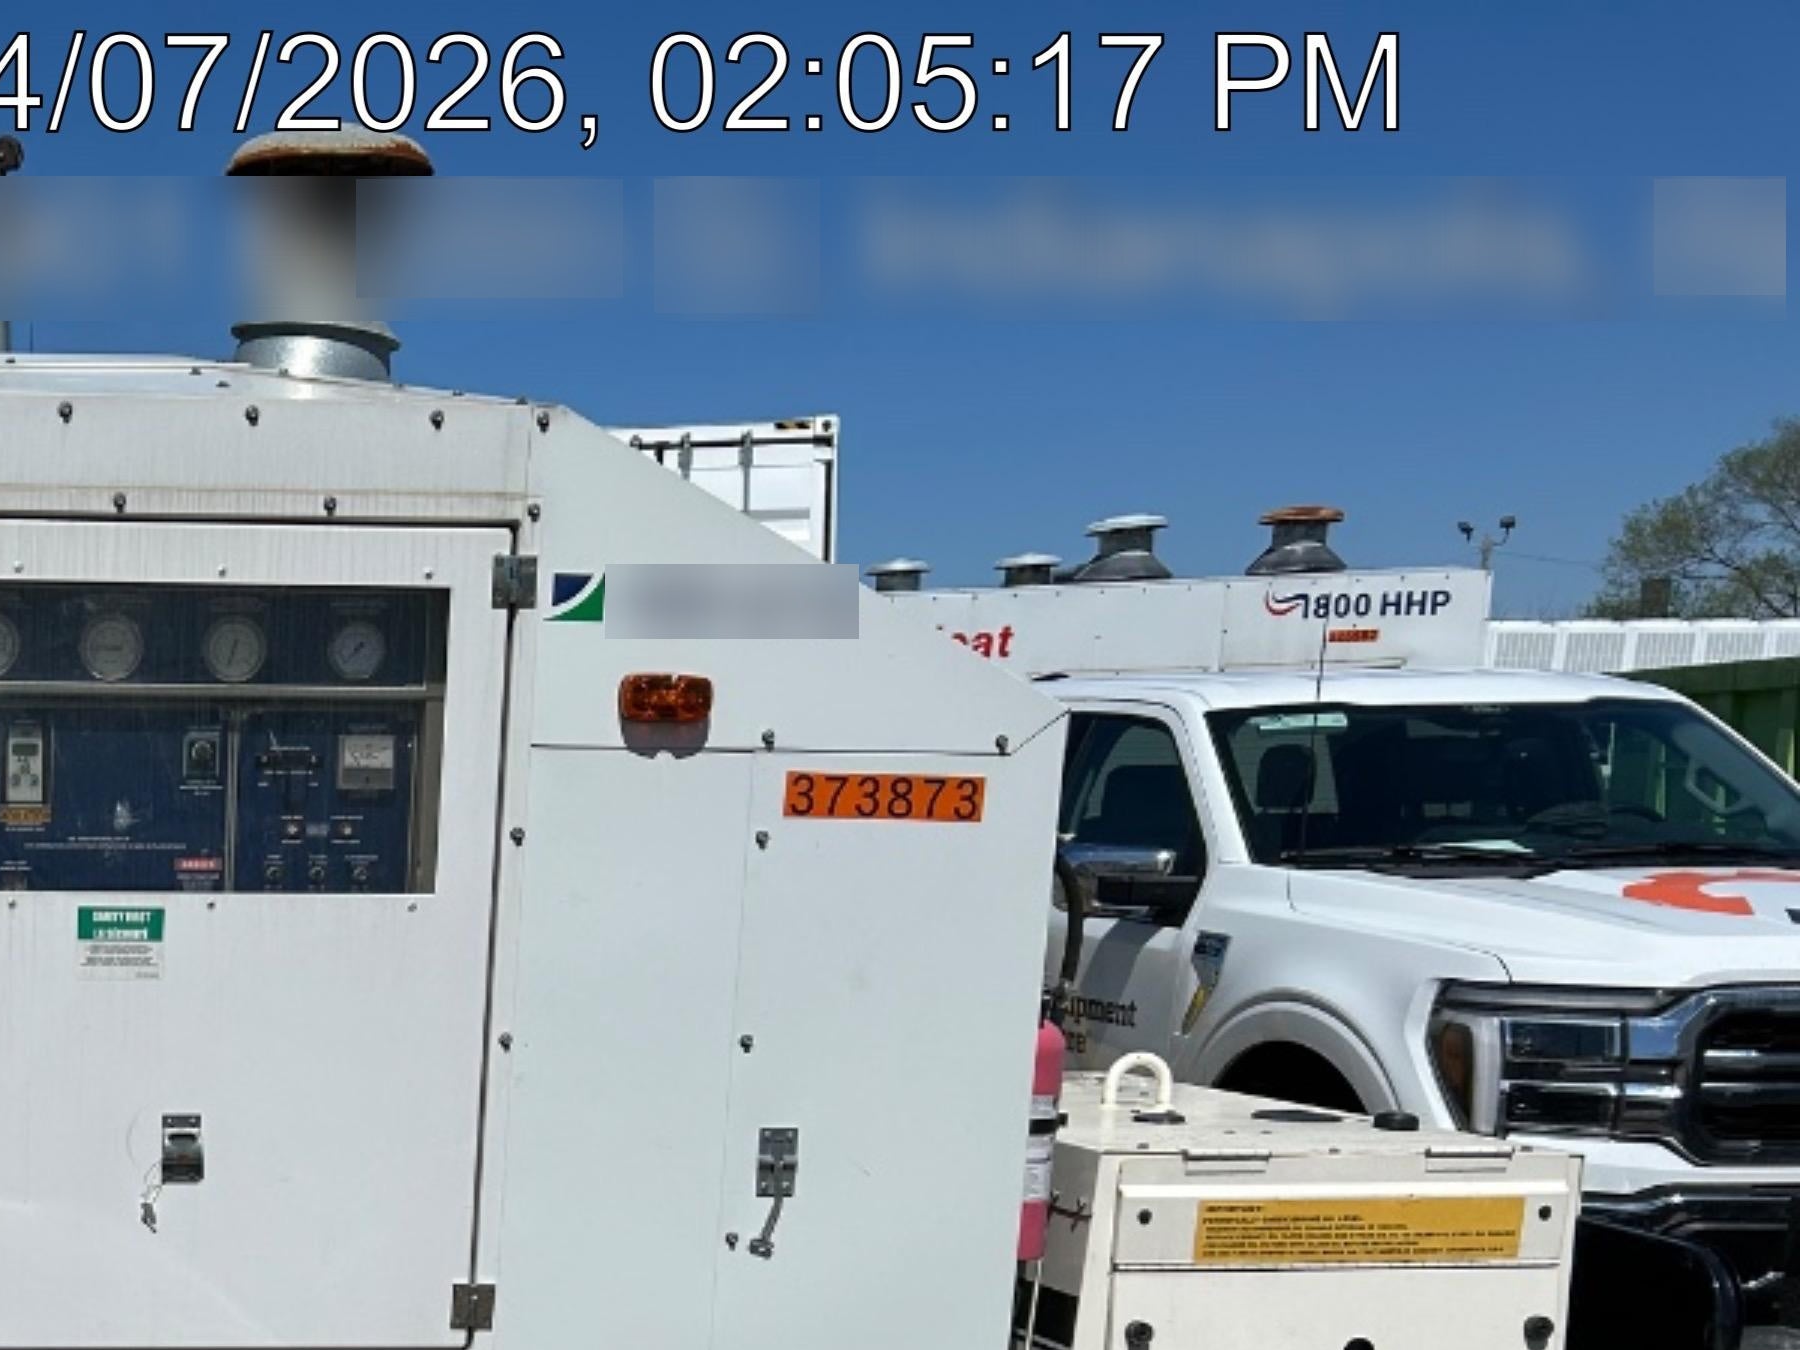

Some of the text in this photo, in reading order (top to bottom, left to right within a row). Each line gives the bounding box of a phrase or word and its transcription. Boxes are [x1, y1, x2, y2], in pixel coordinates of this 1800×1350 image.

[1299, 590, 1452, 620] 1800 HHP
[788, 774, 982, 820] 373873
